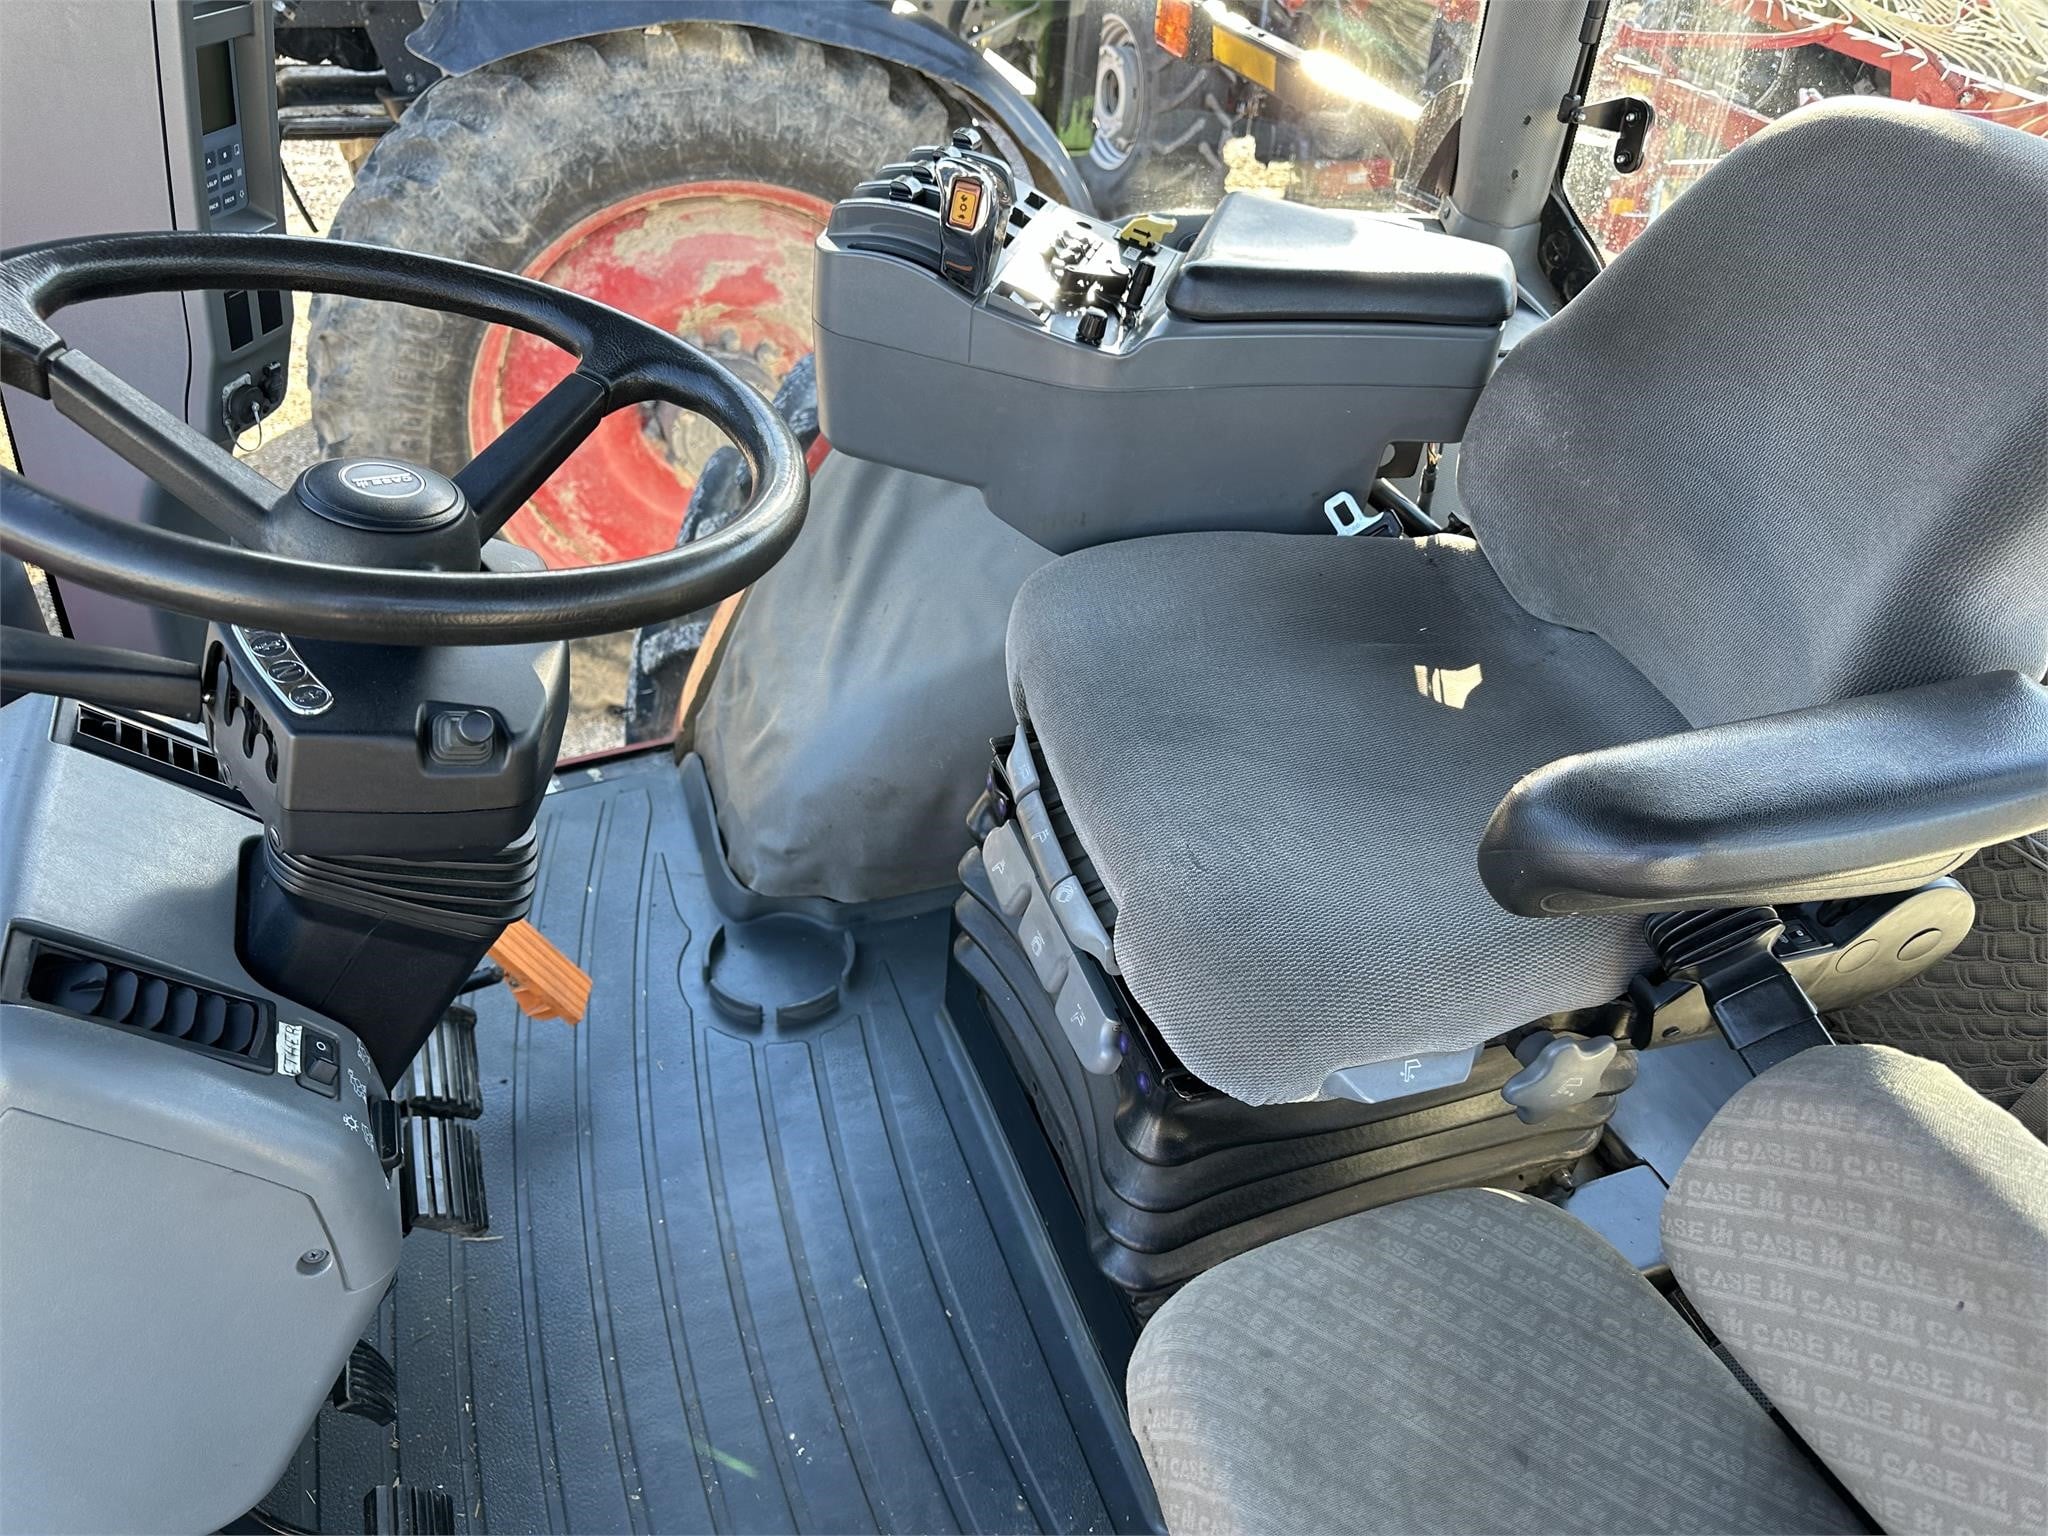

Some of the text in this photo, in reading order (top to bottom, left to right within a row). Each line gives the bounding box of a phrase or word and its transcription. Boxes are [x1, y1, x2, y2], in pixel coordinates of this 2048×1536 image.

[283, 1025, 300, 1075] ETHER
[1781, 1101, 1858, 1129] CASE
[1732, 1140, 1803, 1169] CASE
[1686, 1179, 1753, 1207] CASE
[1790, 1194, 1867, 1229] CASE
[1419, 1222, 1481, 1261] CASE
[1661, 1214, 1705, 1242] ASE
[1741, 1230, 1813, 1264] CASE
[1856, 1254, 1939, 1294] CASE
[1694, 1266, 1762, 1298] CASE
[1801, 1289, 1880, 1328] CASE
[1926, 1320, 2017, 1364] CASE
[1752, 1323, 1826, 1360] CASE
[1868, 1353, 1953, 1395] CASE
[1814, 1384, 1894, 1427] CASE
[1941, 1421, 2035, 1470] CASE
[1881, 1452, 1970, 1499] CASE
